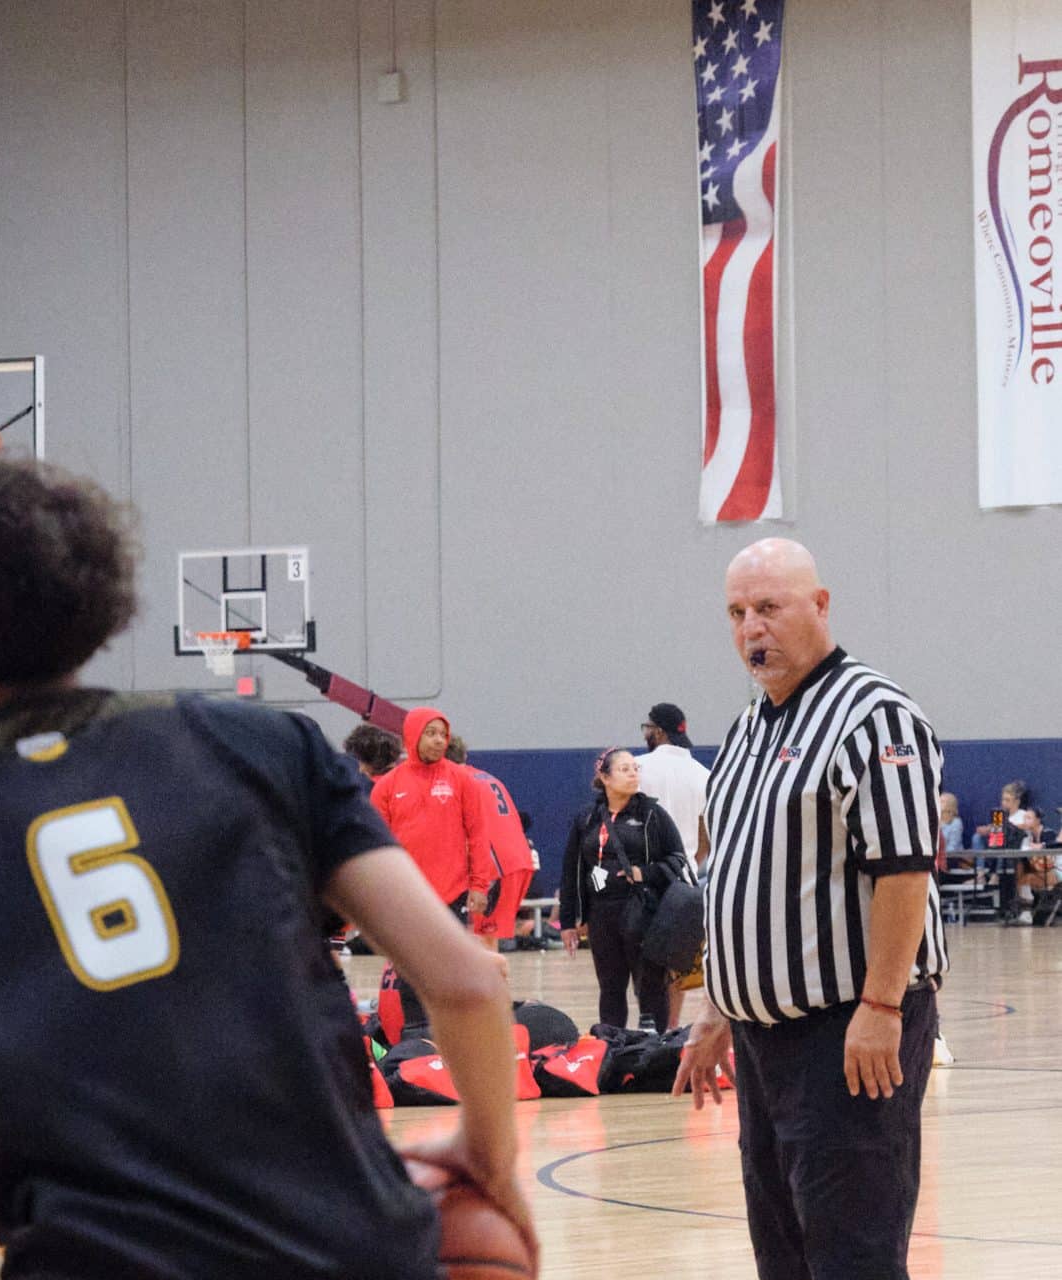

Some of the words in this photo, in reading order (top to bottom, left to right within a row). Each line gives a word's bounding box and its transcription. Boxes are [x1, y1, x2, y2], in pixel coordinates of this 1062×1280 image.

[292, 560, 301, 578] 3
[490, 783, 510, 816] 3
[25, 796, 181, 992] 6
